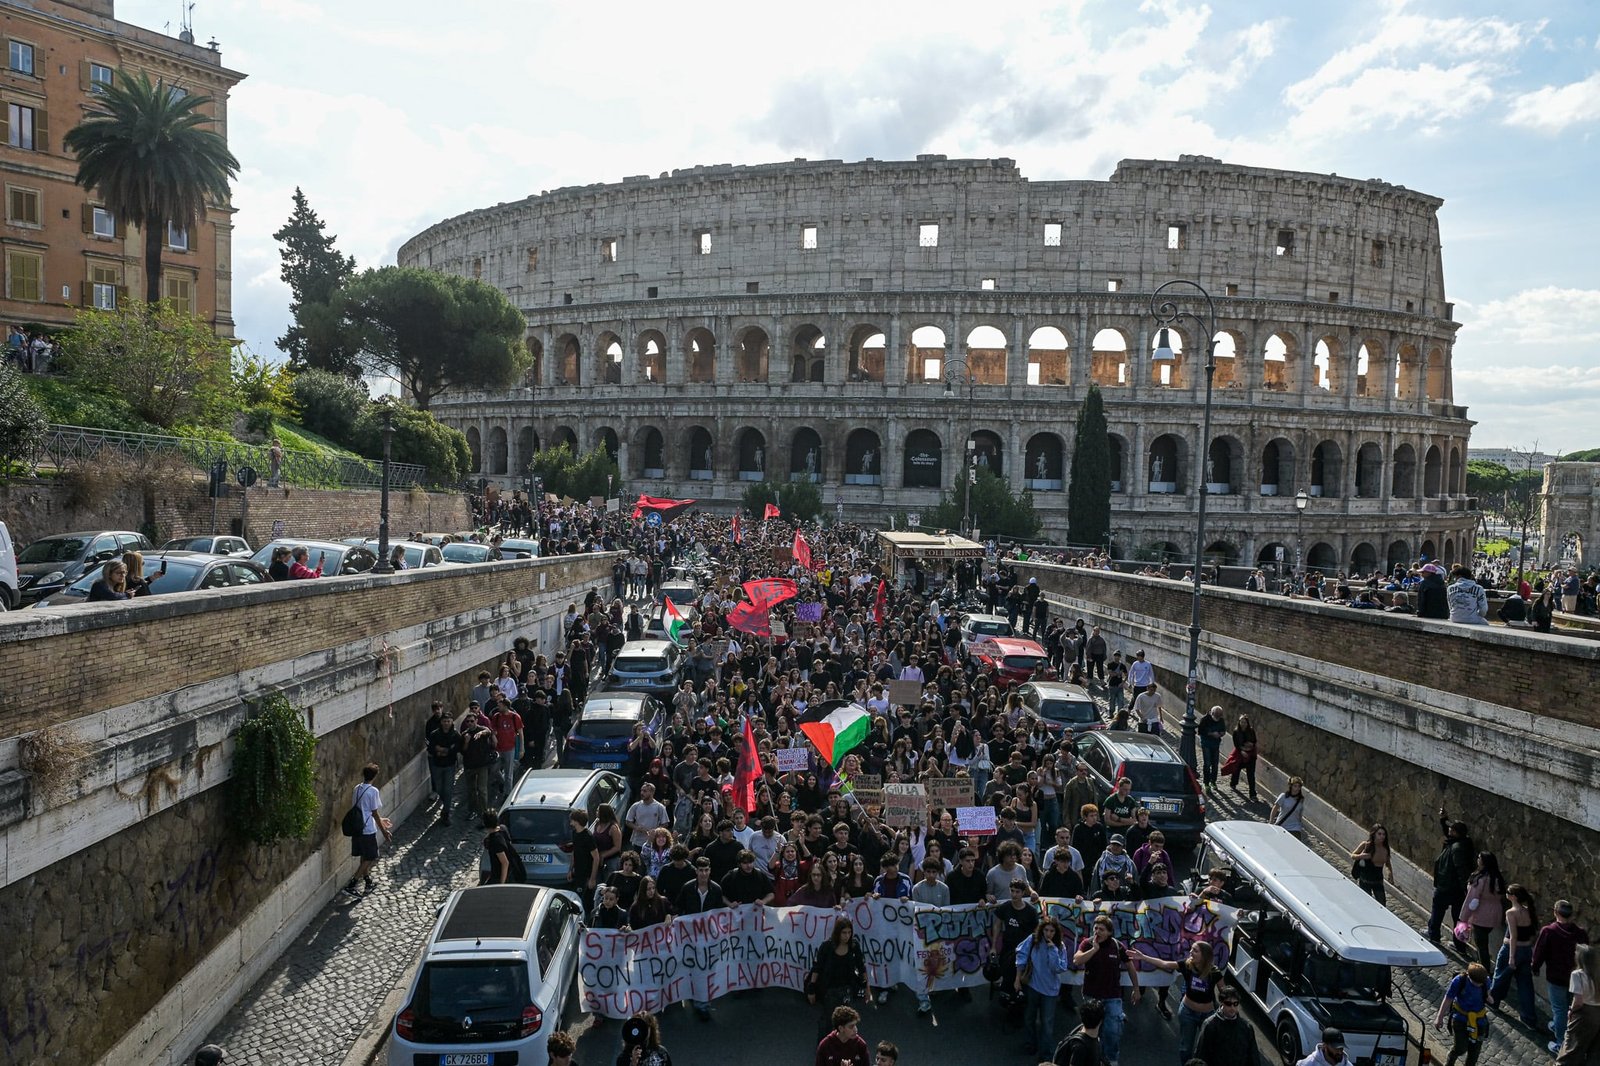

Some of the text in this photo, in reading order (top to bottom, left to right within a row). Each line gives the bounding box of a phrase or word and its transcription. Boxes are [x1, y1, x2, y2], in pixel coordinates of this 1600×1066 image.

[788, 902, 872, 939] FUTO
[581, 956, 677, 988] CONTRO
[706, 973, 719, 1001] E
[726, 961, 808, 989] LAVORAT
[460, 1054, 487, 1065] 726BC
